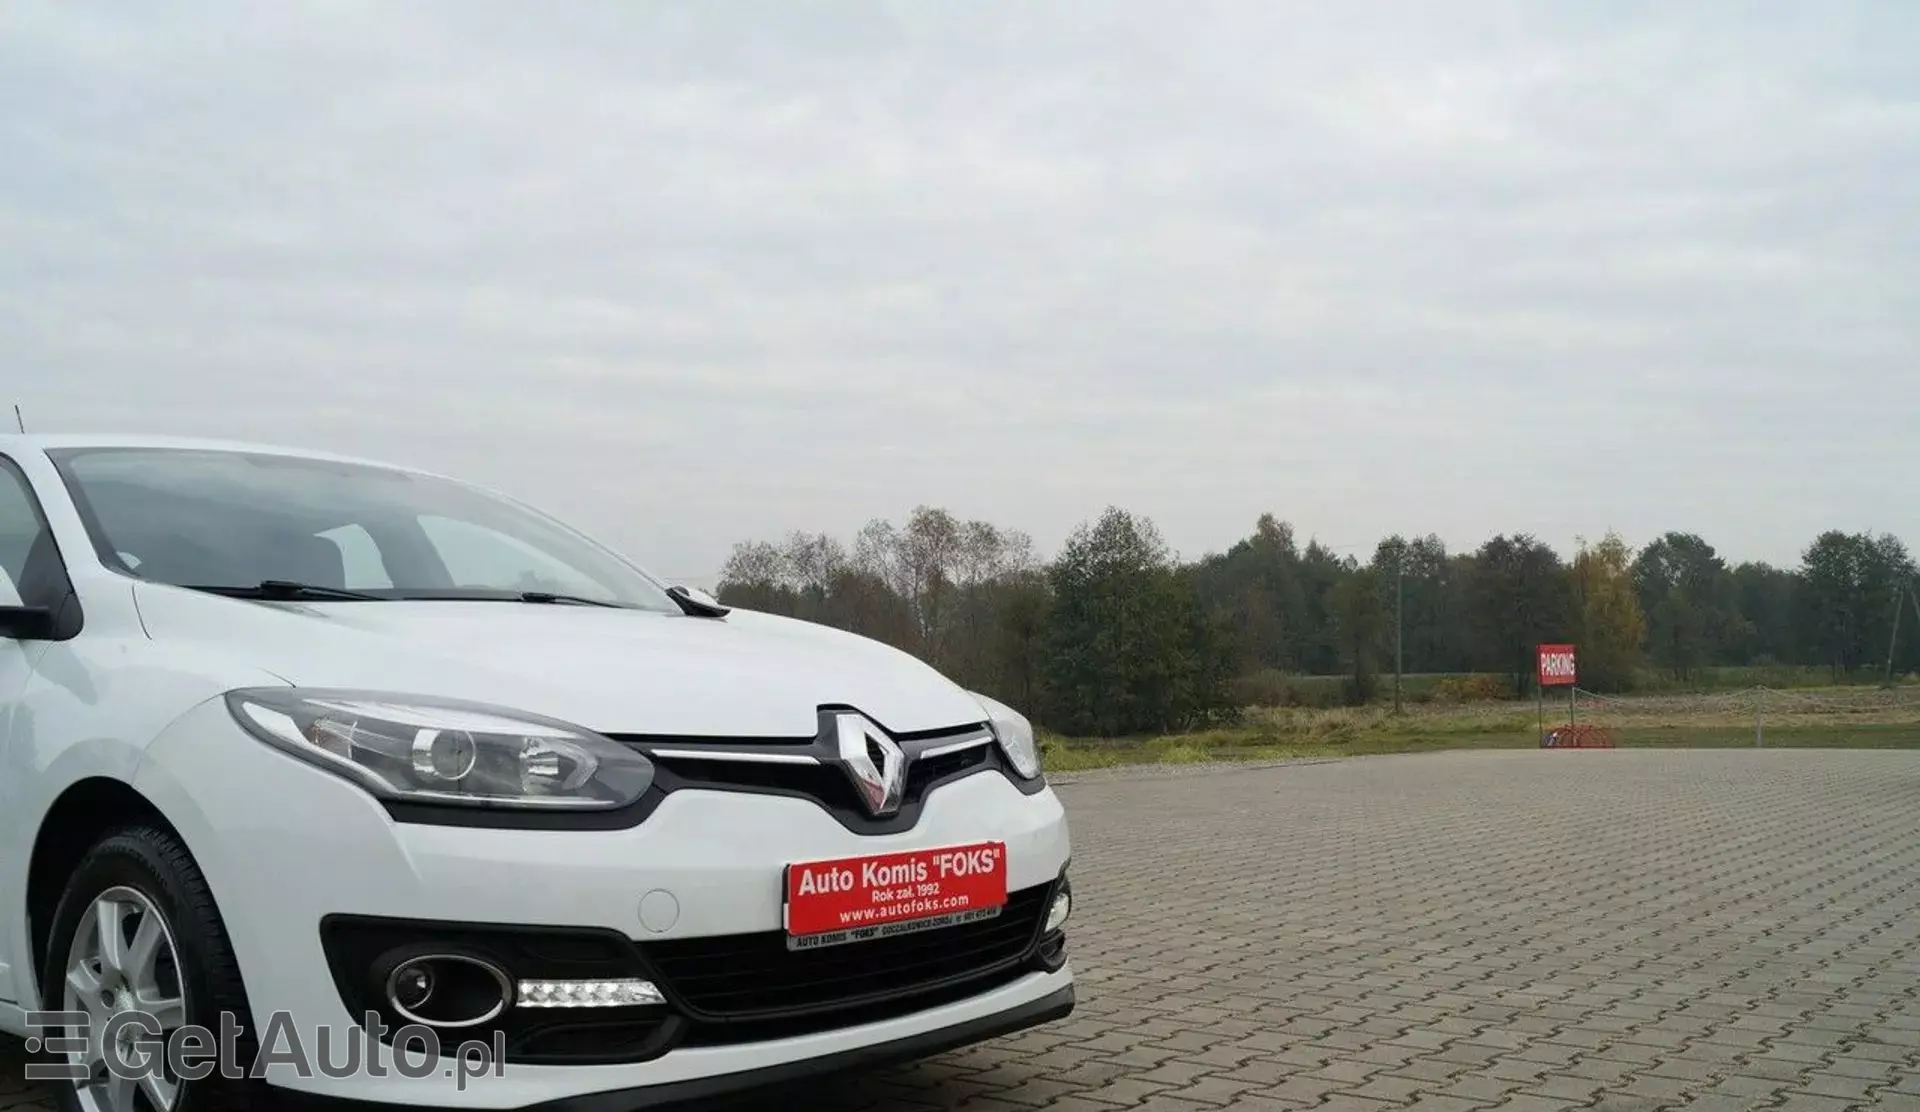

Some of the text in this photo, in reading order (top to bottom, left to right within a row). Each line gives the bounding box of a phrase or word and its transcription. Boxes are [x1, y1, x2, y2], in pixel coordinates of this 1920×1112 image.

[1540, 653, 1576, 676] PARKING
[798, 847, 1001, 897] Auto Komis "FOKS"
[871, 888, 894, 903] Rok
[917, 882, 940, 897] 1992
[840, 894, 969, 923] www.autofoks.com
[796, 935, 819, 948] AUTO
[821, 931, 847, 945] KOMIS
